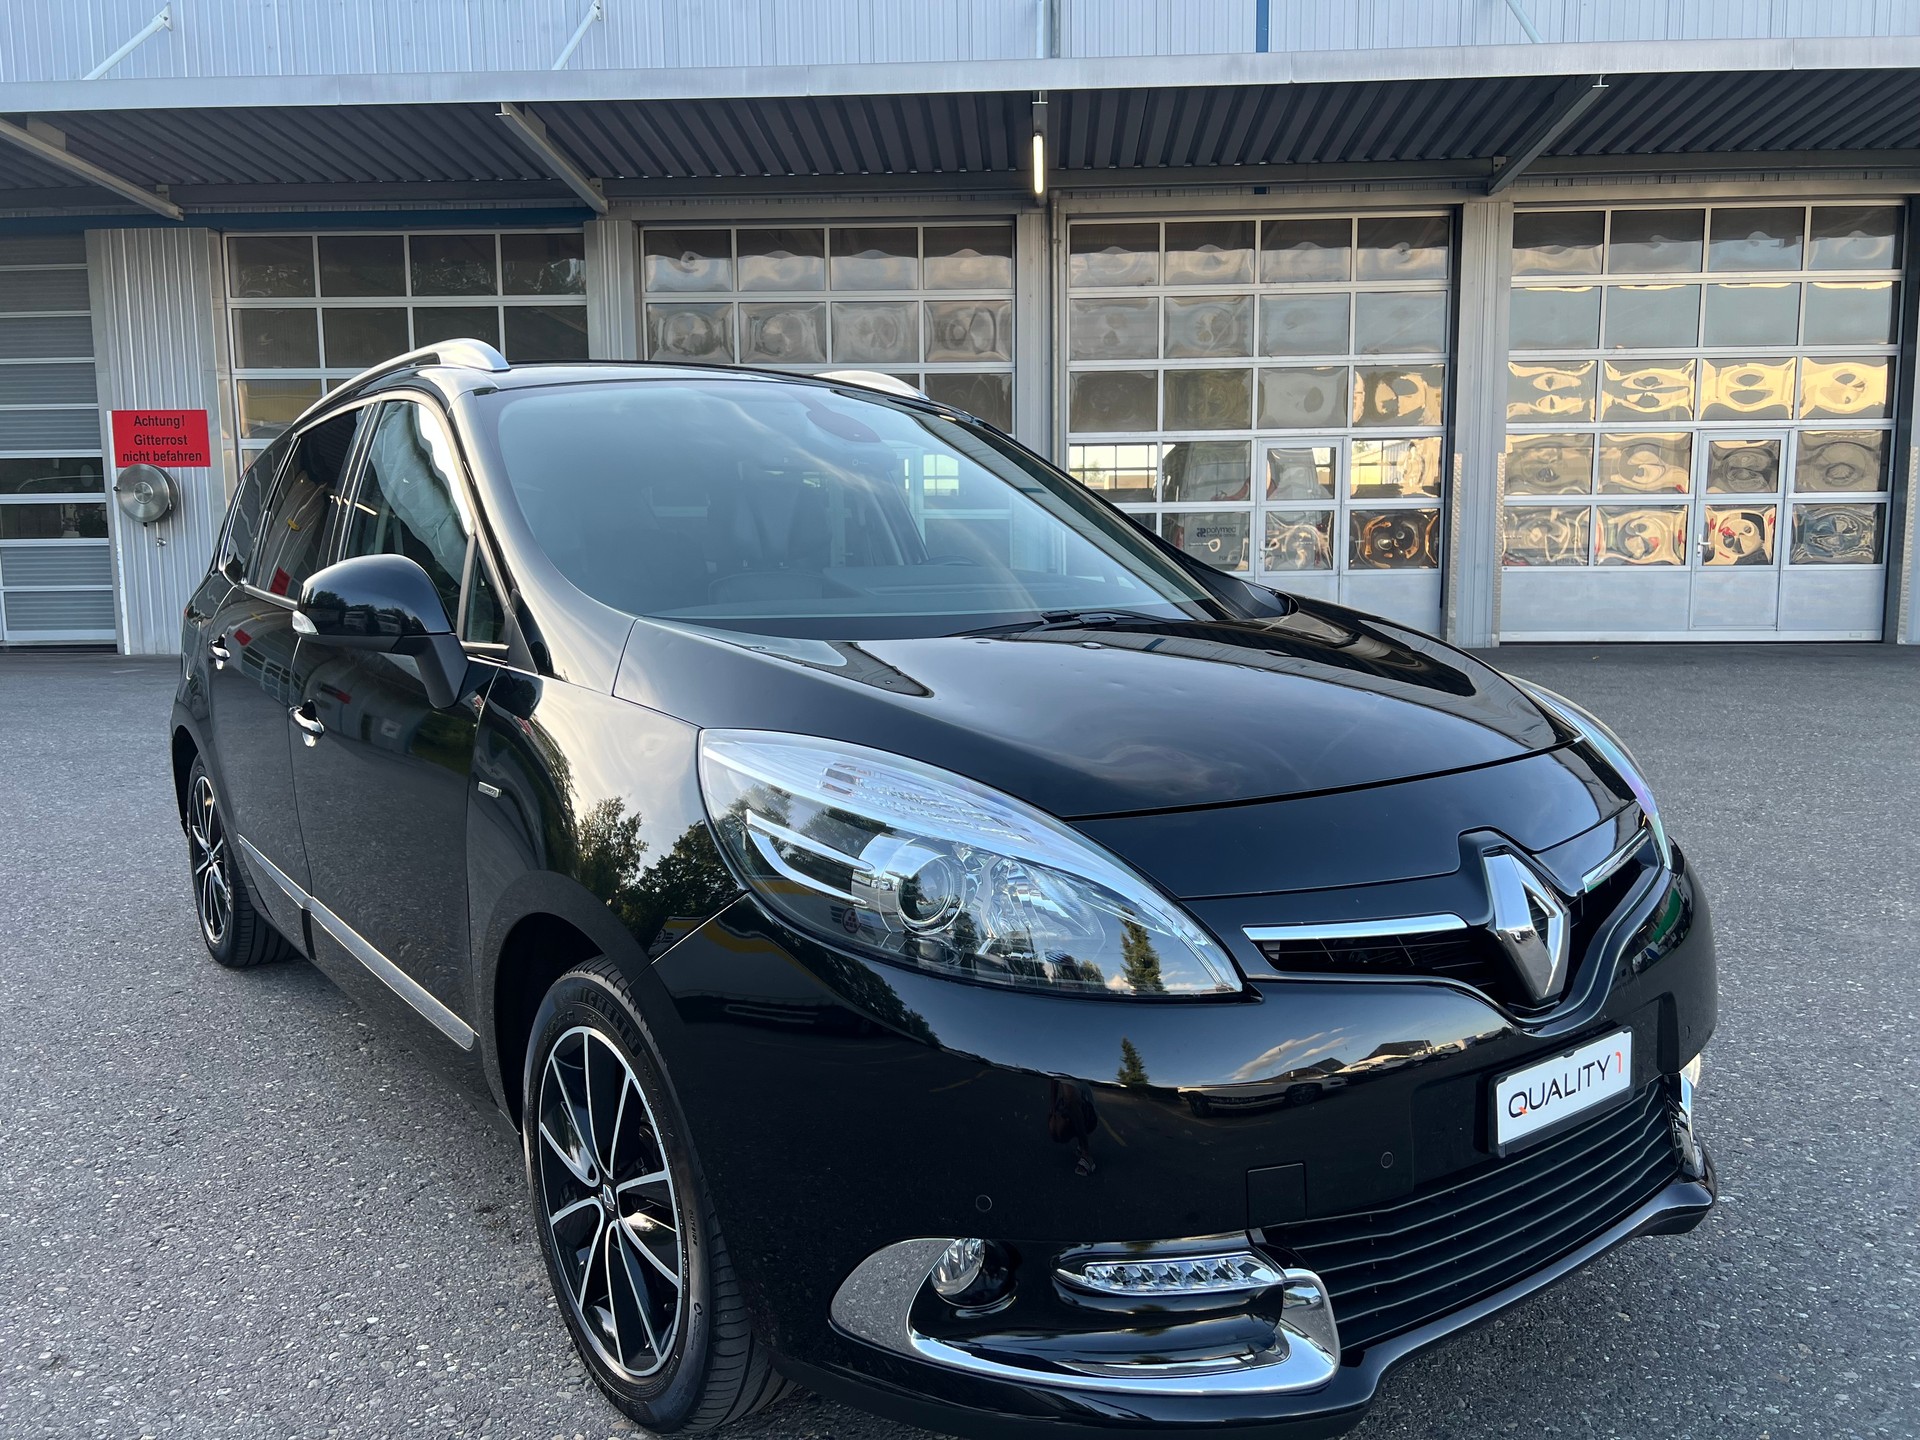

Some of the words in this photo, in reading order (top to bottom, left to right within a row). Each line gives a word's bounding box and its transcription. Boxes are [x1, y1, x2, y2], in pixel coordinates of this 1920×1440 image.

[133, 415, 185, 429] Achtung!
[133, 434, 188, 446] Gitterrost
[122, 450, 151, 462] nicht
[153, 450, 202, 462] befahren
